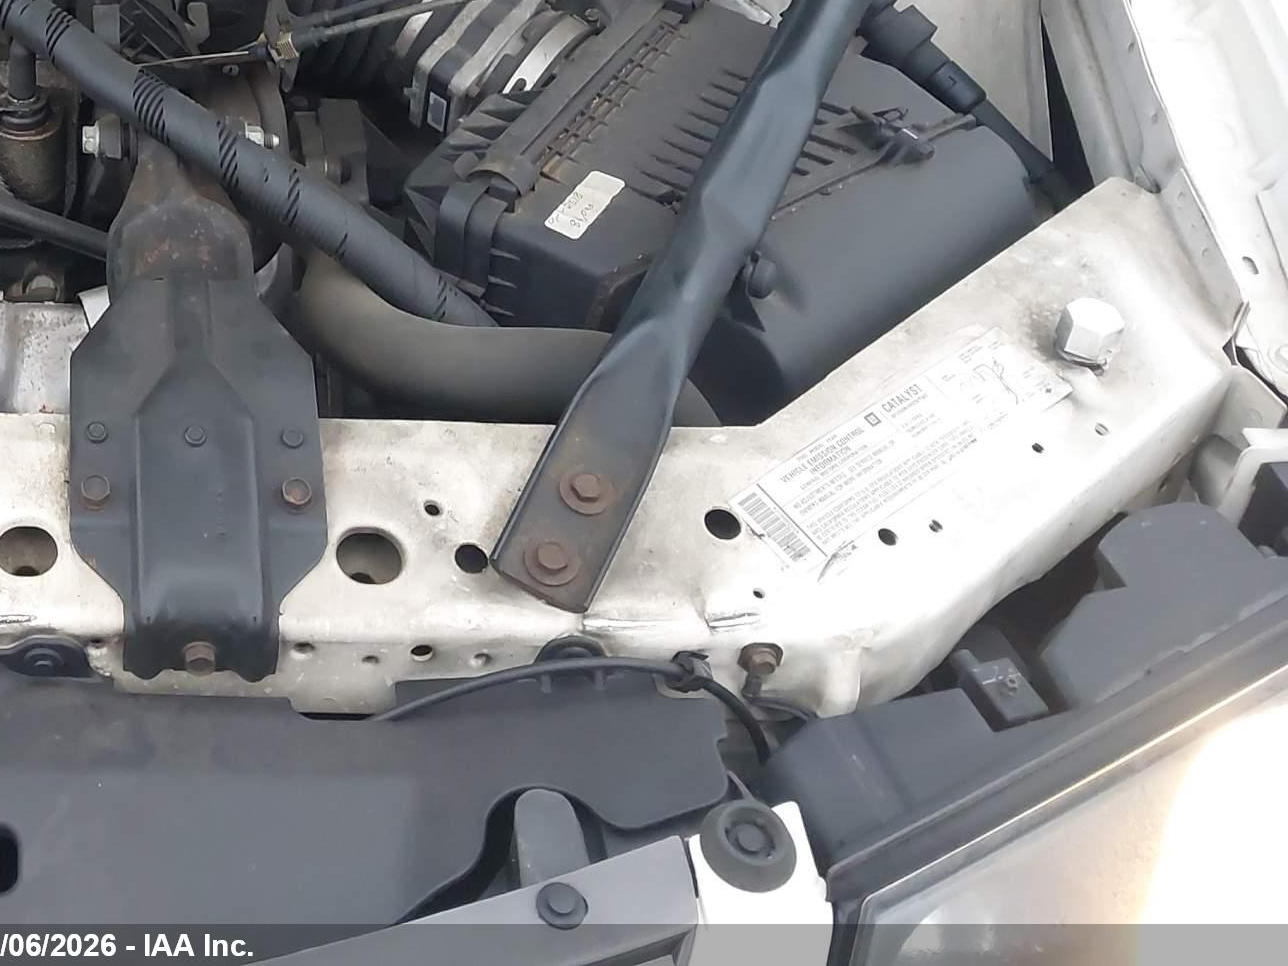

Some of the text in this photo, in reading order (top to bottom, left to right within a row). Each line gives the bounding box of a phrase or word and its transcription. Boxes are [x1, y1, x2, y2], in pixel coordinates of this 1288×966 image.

[881, 382, 923, 414] CATALYST
[780, 463, 808, 484] VEHICLE
[806, 443, 838, 467] EMISSION
[836, 426, 864, 448] CONTROL
[809, 444, 852, 476] INFORMATION
